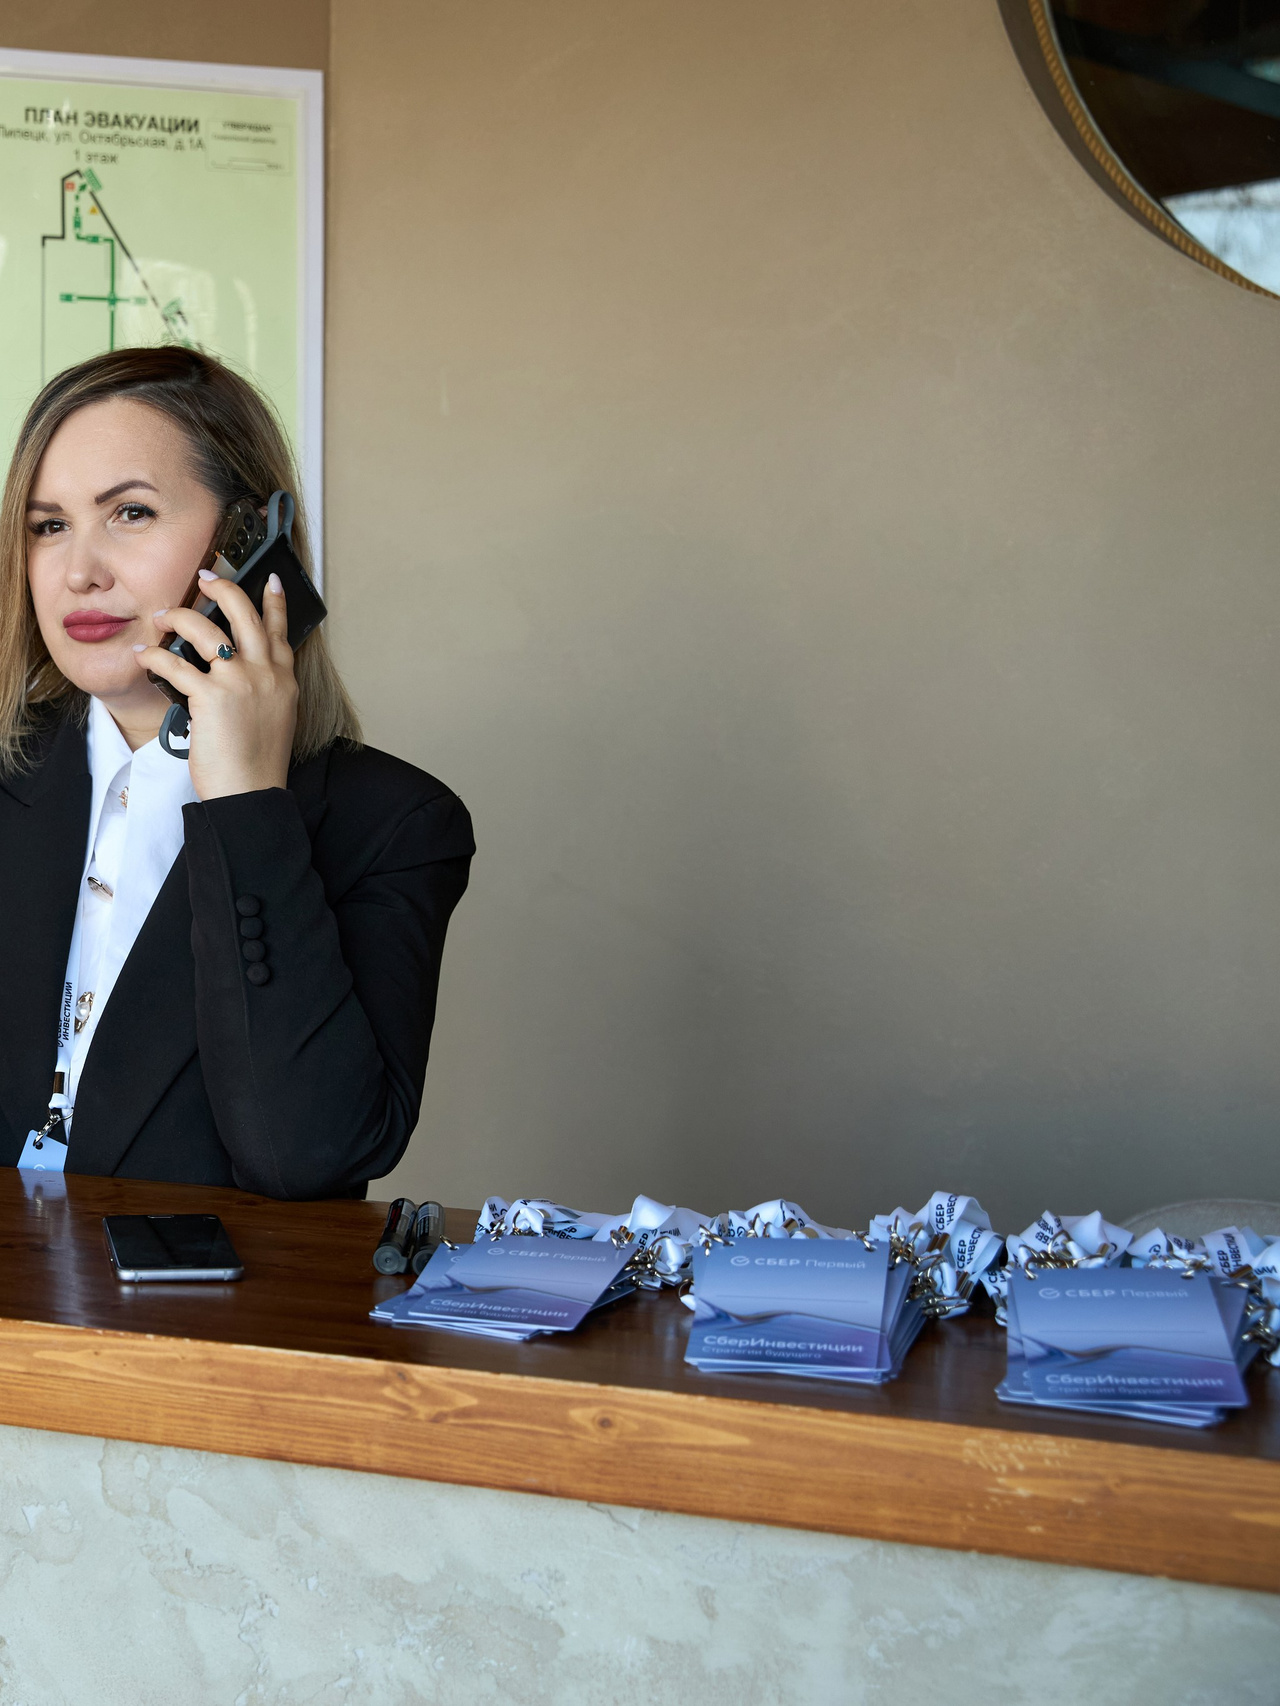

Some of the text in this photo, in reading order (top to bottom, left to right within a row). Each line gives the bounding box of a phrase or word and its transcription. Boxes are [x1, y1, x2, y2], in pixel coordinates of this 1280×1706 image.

[24, 106, 78, 126] ПЛАН
[83, 110, 200, 135] ЭВАКУАЦИИ
[85, 152, 119, 165] этаж
[62, 981, 73, 1041] ИНВЕСТИЦИИ
[935, 1203, 945, 1231] СБЕР
[508, 1249, 607, 1262] СБЕР Первый
[754, 1257, 866, 1269] СБЕР Первый
[956, 1239, 967, 1269] СБЕР
[1217, 1249, 1231, 1275] СБЕР
[1065, 1288, 1189, 1299] СБЕР Первый
[430, 1298, 569, 1318] СберИнвестиции
[702, 1346, 822, 1359] Стратегии будущего
[703, 1335, 863, 1353] СберИнвестиции
[1045, 1374, 1224, 1388] СберИнвестиции
